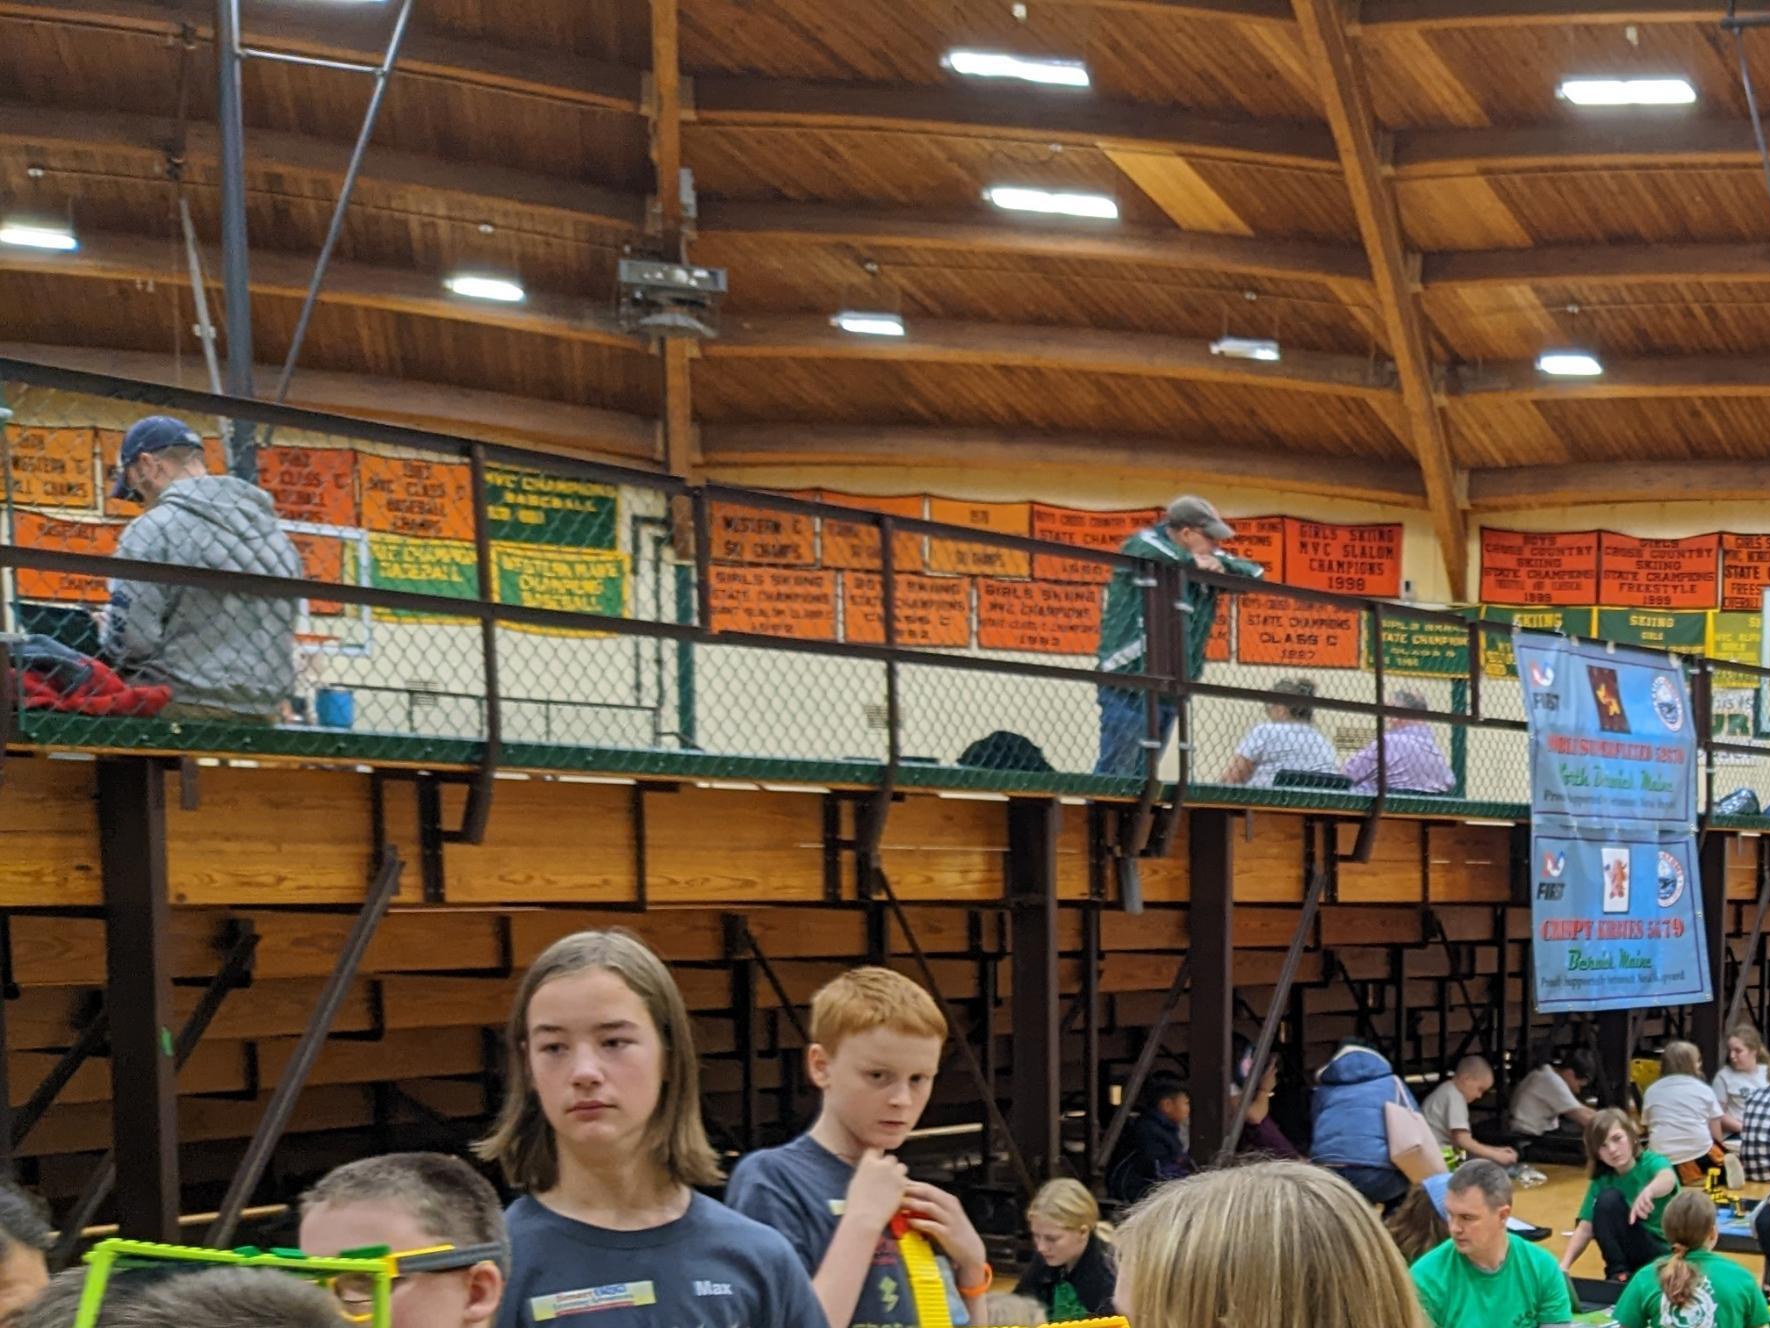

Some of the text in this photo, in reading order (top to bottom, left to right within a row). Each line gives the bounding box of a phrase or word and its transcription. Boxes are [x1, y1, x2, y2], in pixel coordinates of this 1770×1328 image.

[1299, 524, 1395, 543] GIRLS SKIING
[1299, 541, 1395, 561] MVC SLALOM
[1530, 544, 1594, 557] COUNTRY
[1603, 545, 1714, 559] CROSS COUNTRY
[1309, 559, 1385, 577] CHAMPIONS
[1516, 558, 1563, 570] SKIING
[1635, 561, 1682, 572] SKIING
[1484, 568, 1595, 581] STATE CHAMPIONS
[1602, 569, 1714, 582] STATE CHAMPIONS
[1726, 565, 1760, 580] STATE
[1620, 583, 1697, 595] FREESTYLE
[1513, 613, 1563, 629] SKIING
[1629, 615, 1675, 628] SKIING
[1259, 631, 1319, 645] CLASS
[694, 1280, 736, 1297] Max
